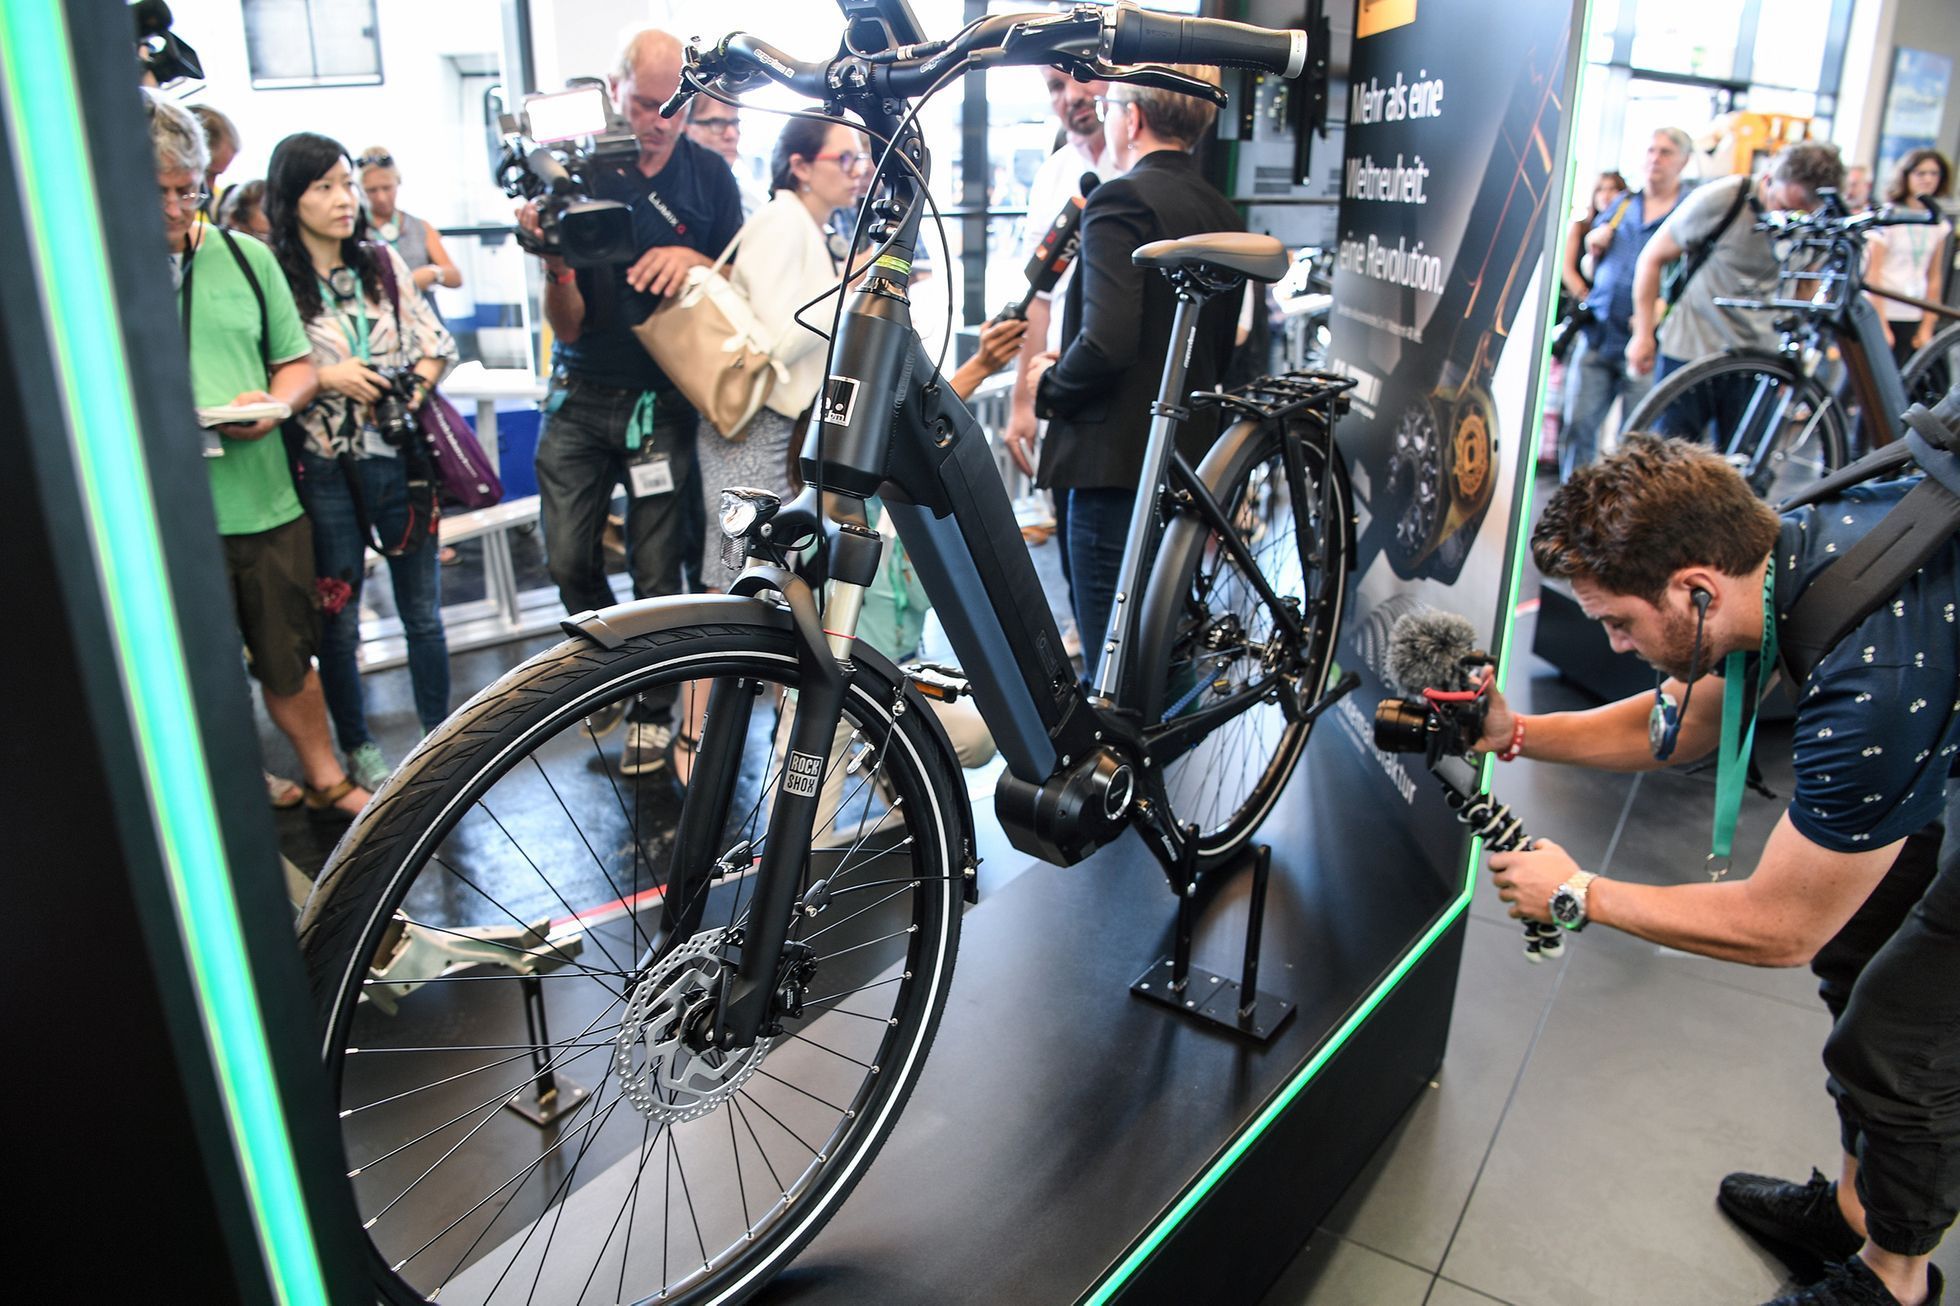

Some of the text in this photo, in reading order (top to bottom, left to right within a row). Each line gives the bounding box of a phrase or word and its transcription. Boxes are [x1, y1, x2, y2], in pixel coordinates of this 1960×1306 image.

[1350, 68, 1444, 125] Mehr als eine
[1340, 230, 1444, 295] eine Revolution.
[787, 773, 816, 793] SHOX
[791, 754, 820, 776] ROCK
